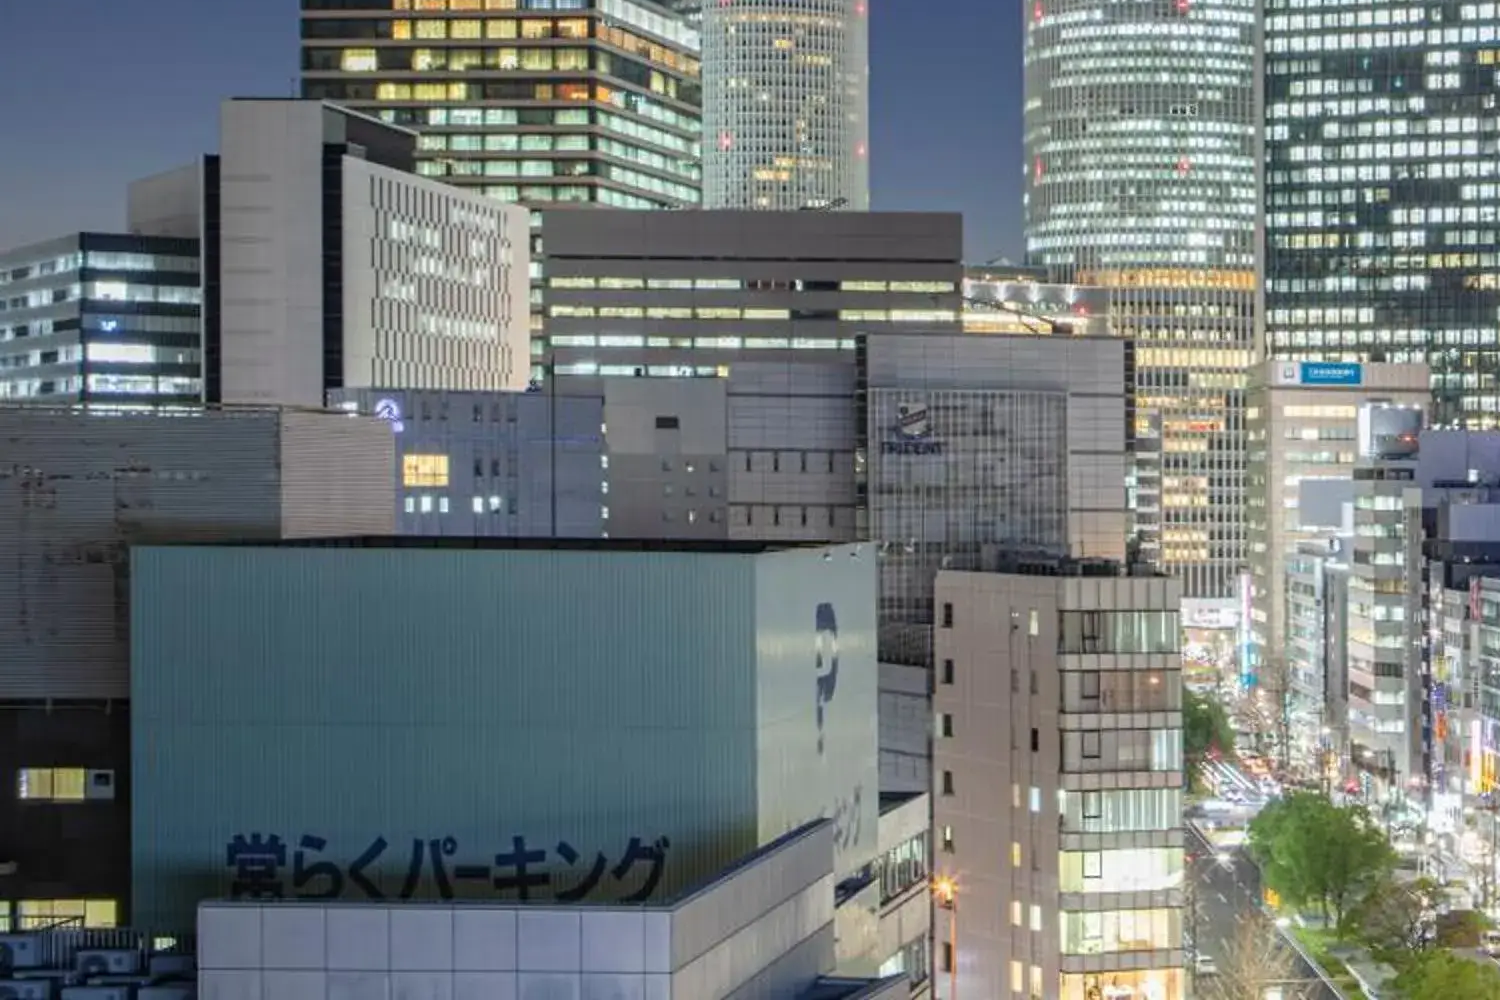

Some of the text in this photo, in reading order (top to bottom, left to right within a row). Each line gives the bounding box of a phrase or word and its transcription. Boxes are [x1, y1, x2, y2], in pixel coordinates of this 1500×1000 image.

[226, 832, 670, 900] 常らくパーキング
